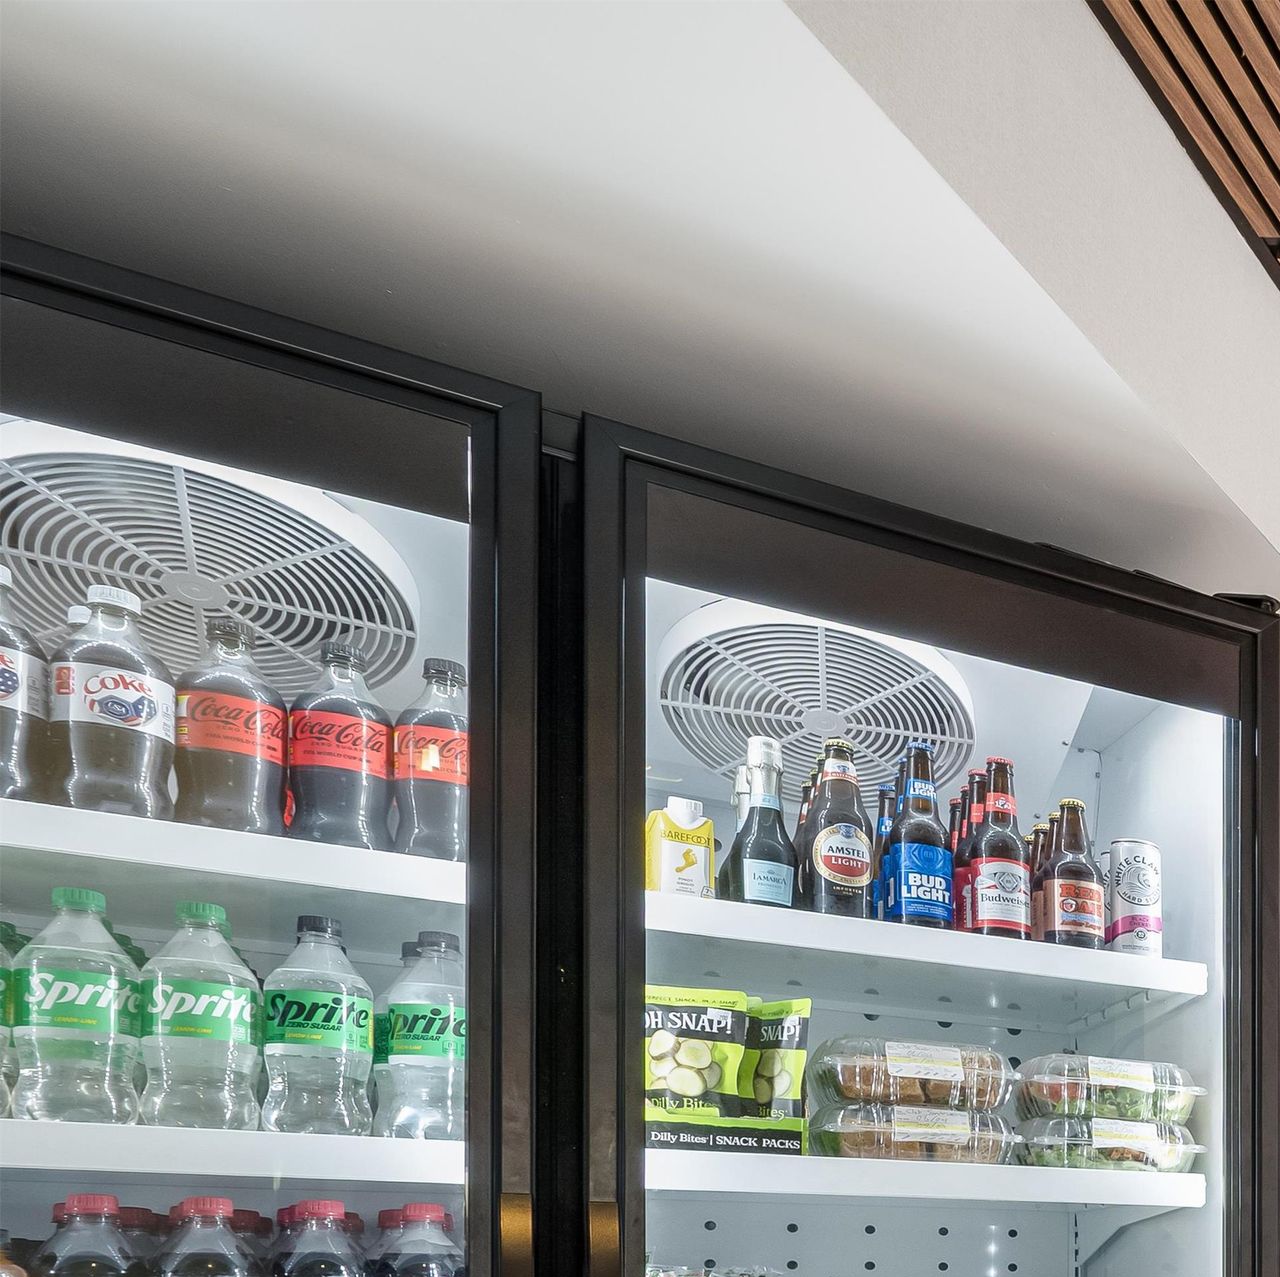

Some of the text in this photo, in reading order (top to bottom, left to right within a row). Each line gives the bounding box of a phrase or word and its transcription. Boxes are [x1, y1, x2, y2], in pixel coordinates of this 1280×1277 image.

[84, 674, 153, 698] Coke
[293, 716, 384, 752] Coca-Cola
[910, 787, 936, 799] LIGHT
[914, 780, 934, 791] BUD
[661, 830, 711, 846] BAREFOOT
[827, 845, 866, 859] AMSTEL
[831, 856, 863, 869] LIGHT
[1115, 856, 1160, 886] WHITE CLAW
[908, 872, 946, 889] BUD
[902, 886, 951, 904] LIGHT
[981, 892, 1030, 907] Budweiser
[1059, 883, 1101, 898] RED
[1122, 891, 1143, 903] HARD
[28, 973, 139, 1012] Sprite
[147, 985, 256, 1023] Sprite
[267, 993, 368, 1029] Sprite
[667, 1011, 733, 1035] SNAP!
[760, 1023, 801, 1043] SNAP!
[651, 1132, 800, 1150] Dilly Bites SNACK PACKS
